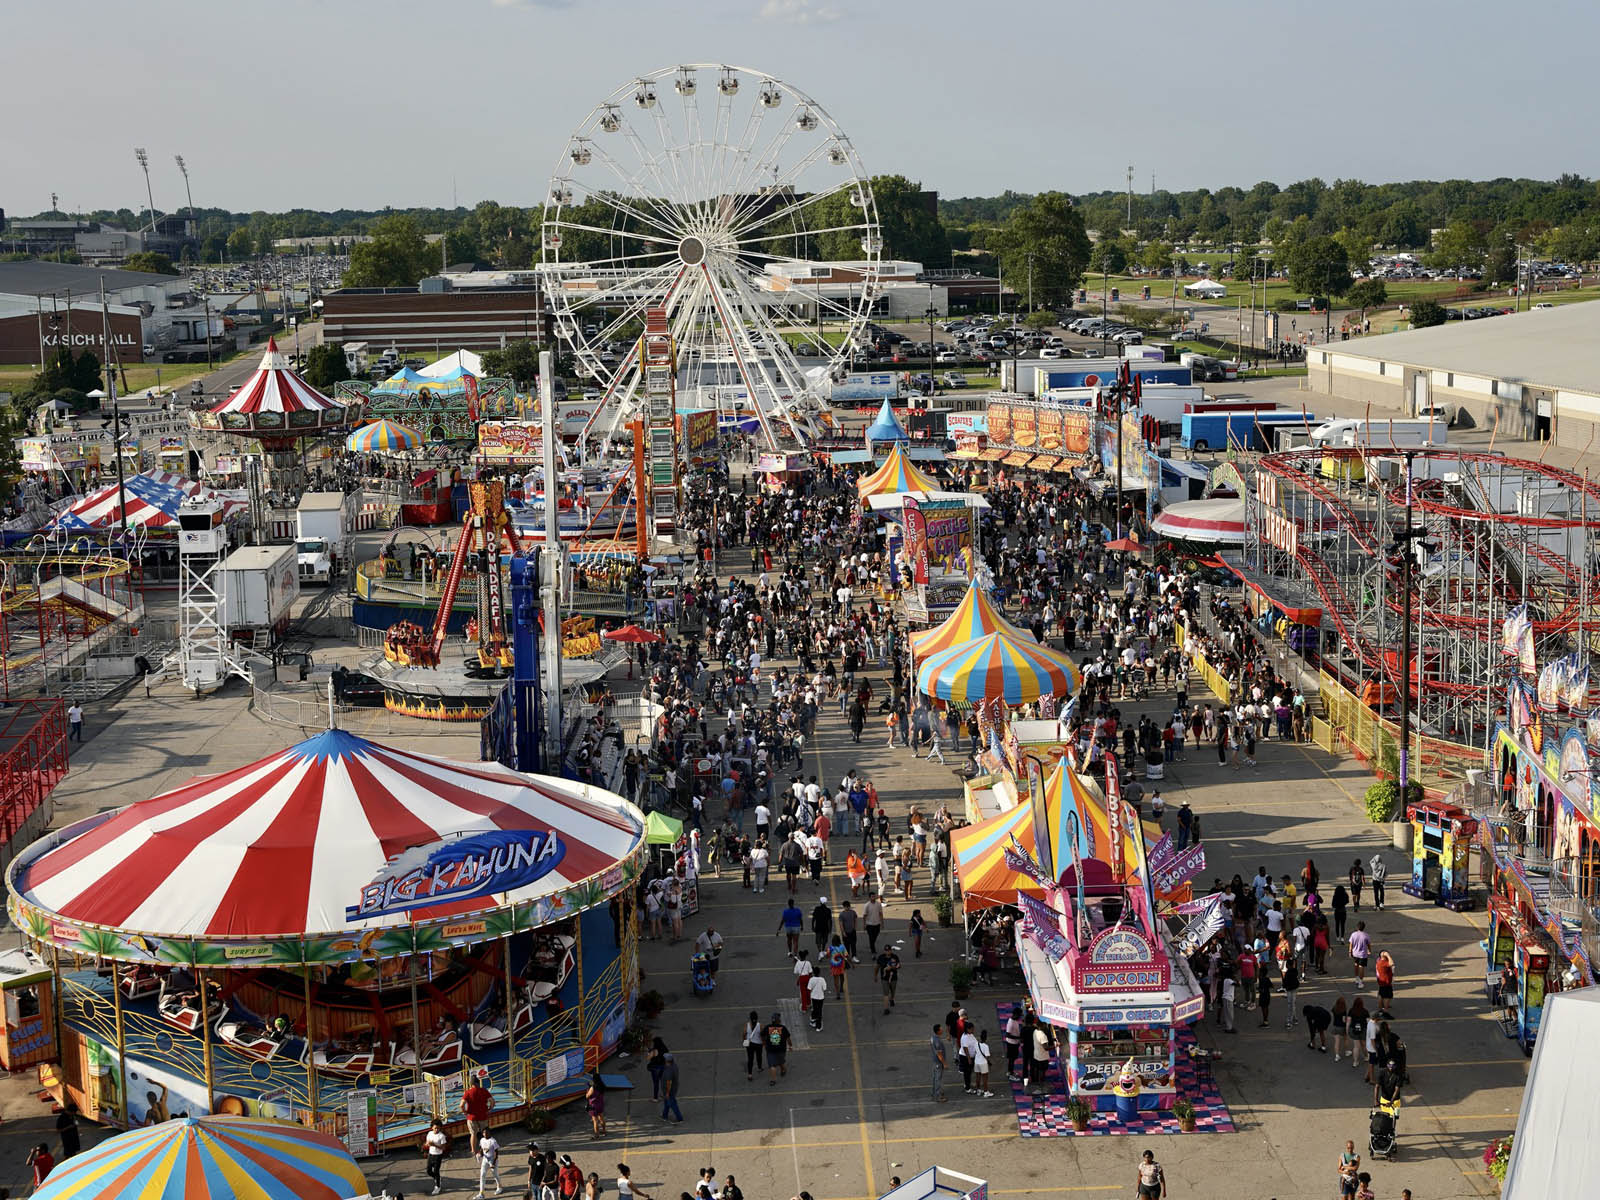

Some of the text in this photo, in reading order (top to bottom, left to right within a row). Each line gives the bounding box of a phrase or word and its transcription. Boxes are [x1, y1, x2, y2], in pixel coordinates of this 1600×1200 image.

[42, 333, 95, 346] KASICH
[694, 412, 713, 431] HOOP
[499, 430, 514, 438] CORN
[1255, 471, 1277, 508] IRON
[907, 513, 917, 542] CORN
[1266, 510, 1297, 556] DRAGON
[920, 549, 929, 578] DOGS
[486, 531, 500, 627] DOWNDRAFT
[358, 831, 558, 914] BIG KAHUNA
[1095, 933, 1149, 961] FRESH FRIED
[1105, 952, 1138, 961] TREATS
[1084, 972, 1160, 987] POPCORN
[1086, 1010, 1124, 1022] FRIED
[1125, 1008, 1168, 1020] OREOS
[1085, 1062, 1164, 1074] DEEP RIED
[1081, 1077, 1106, 1086] OREO
